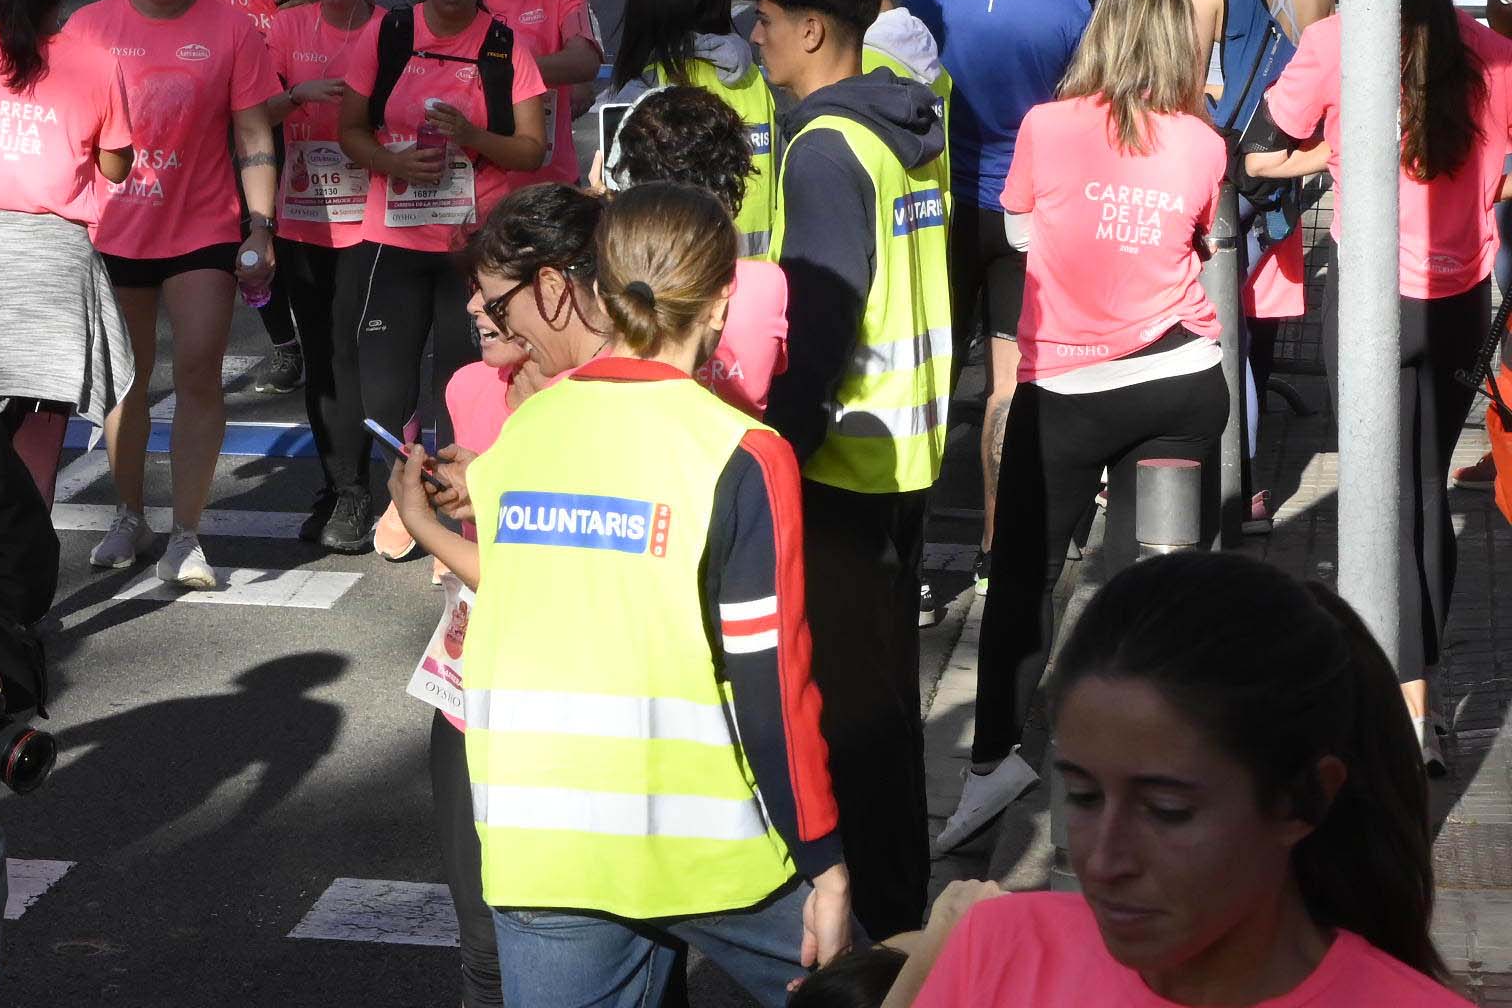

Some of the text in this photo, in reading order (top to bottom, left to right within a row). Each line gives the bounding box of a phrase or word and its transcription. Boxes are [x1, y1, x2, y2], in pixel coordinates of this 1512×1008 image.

[292, 51, 328, 64] OYSHO
[17, 120, 40, 138] LA
[311, 173, 341, 185] 016
[1083, 181, 1185, 215] CARRERA
[1102, 202, 1161, 228] DE LA
[1096, 224, 1162, 247] MUJER
[1057, 344, 1110, 357] OYSHO
[498, 504, 645, 540] VOLUNTARIS
